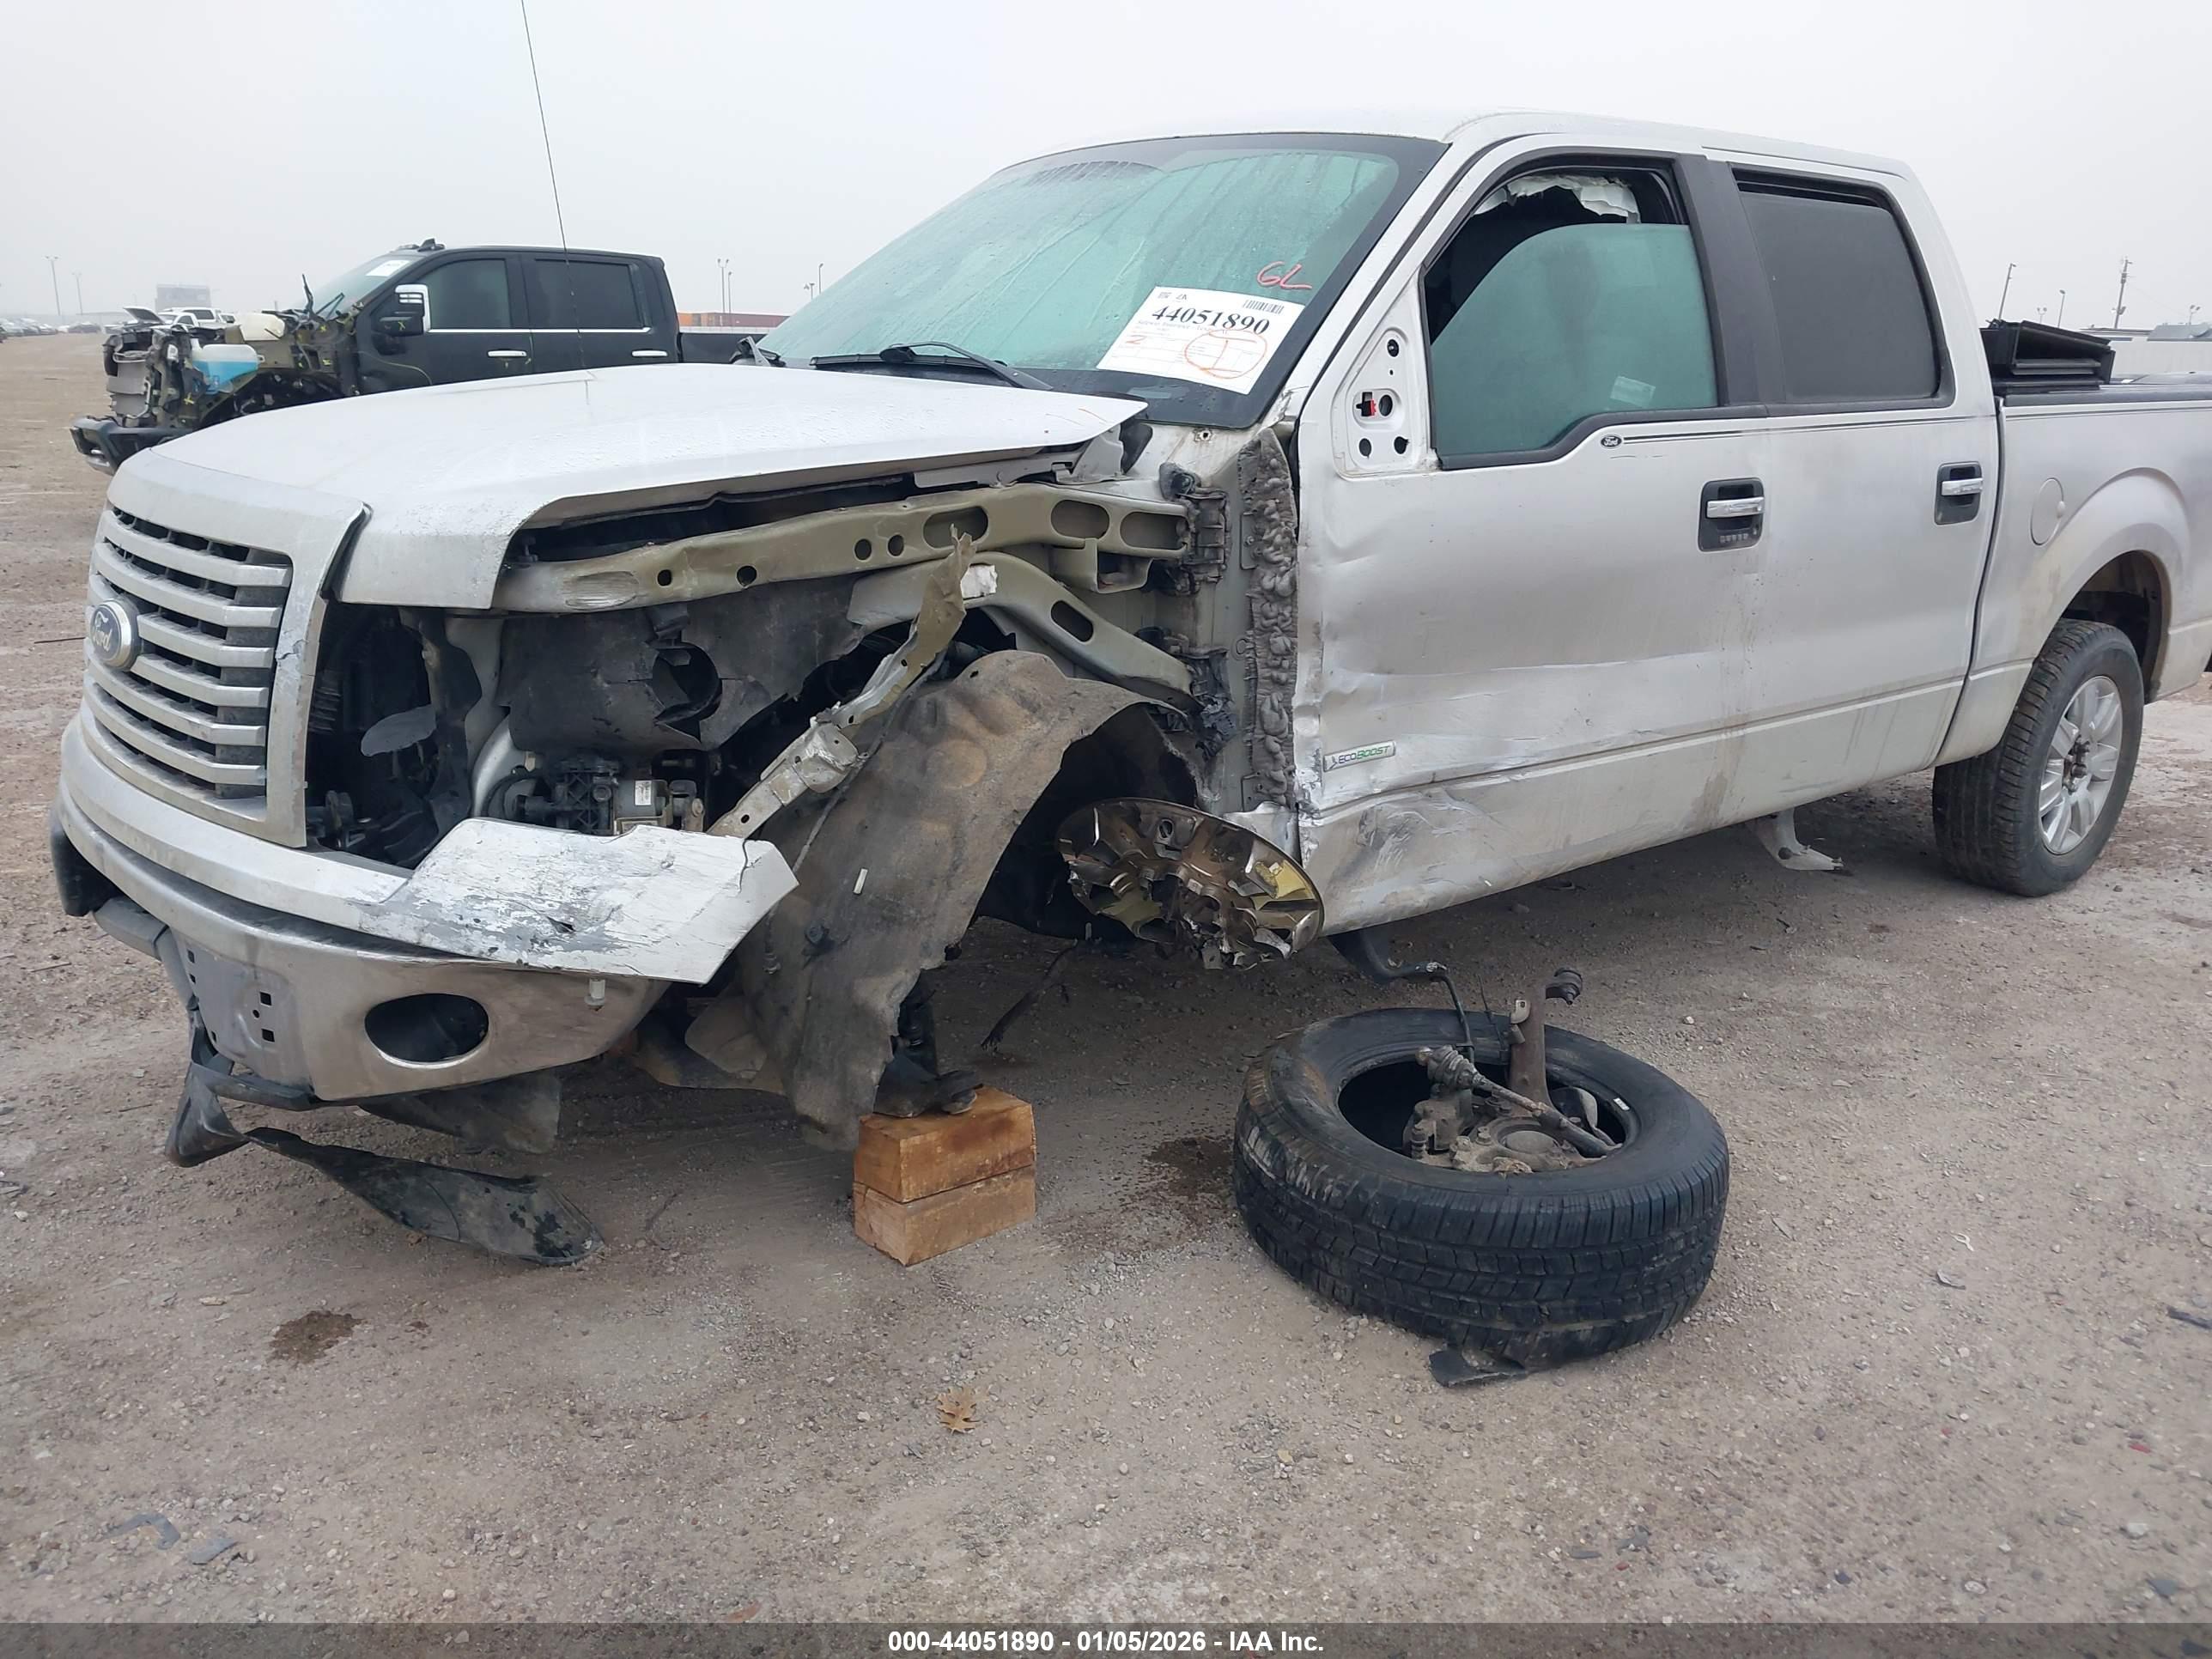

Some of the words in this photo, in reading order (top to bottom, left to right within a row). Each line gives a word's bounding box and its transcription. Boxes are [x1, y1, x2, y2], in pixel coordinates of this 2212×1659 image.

[1152, 306, 1270, 335] 44051890
[94, 611, 113, 653] Ford
[1338, 745, 1390, 764] ECOBOOST
